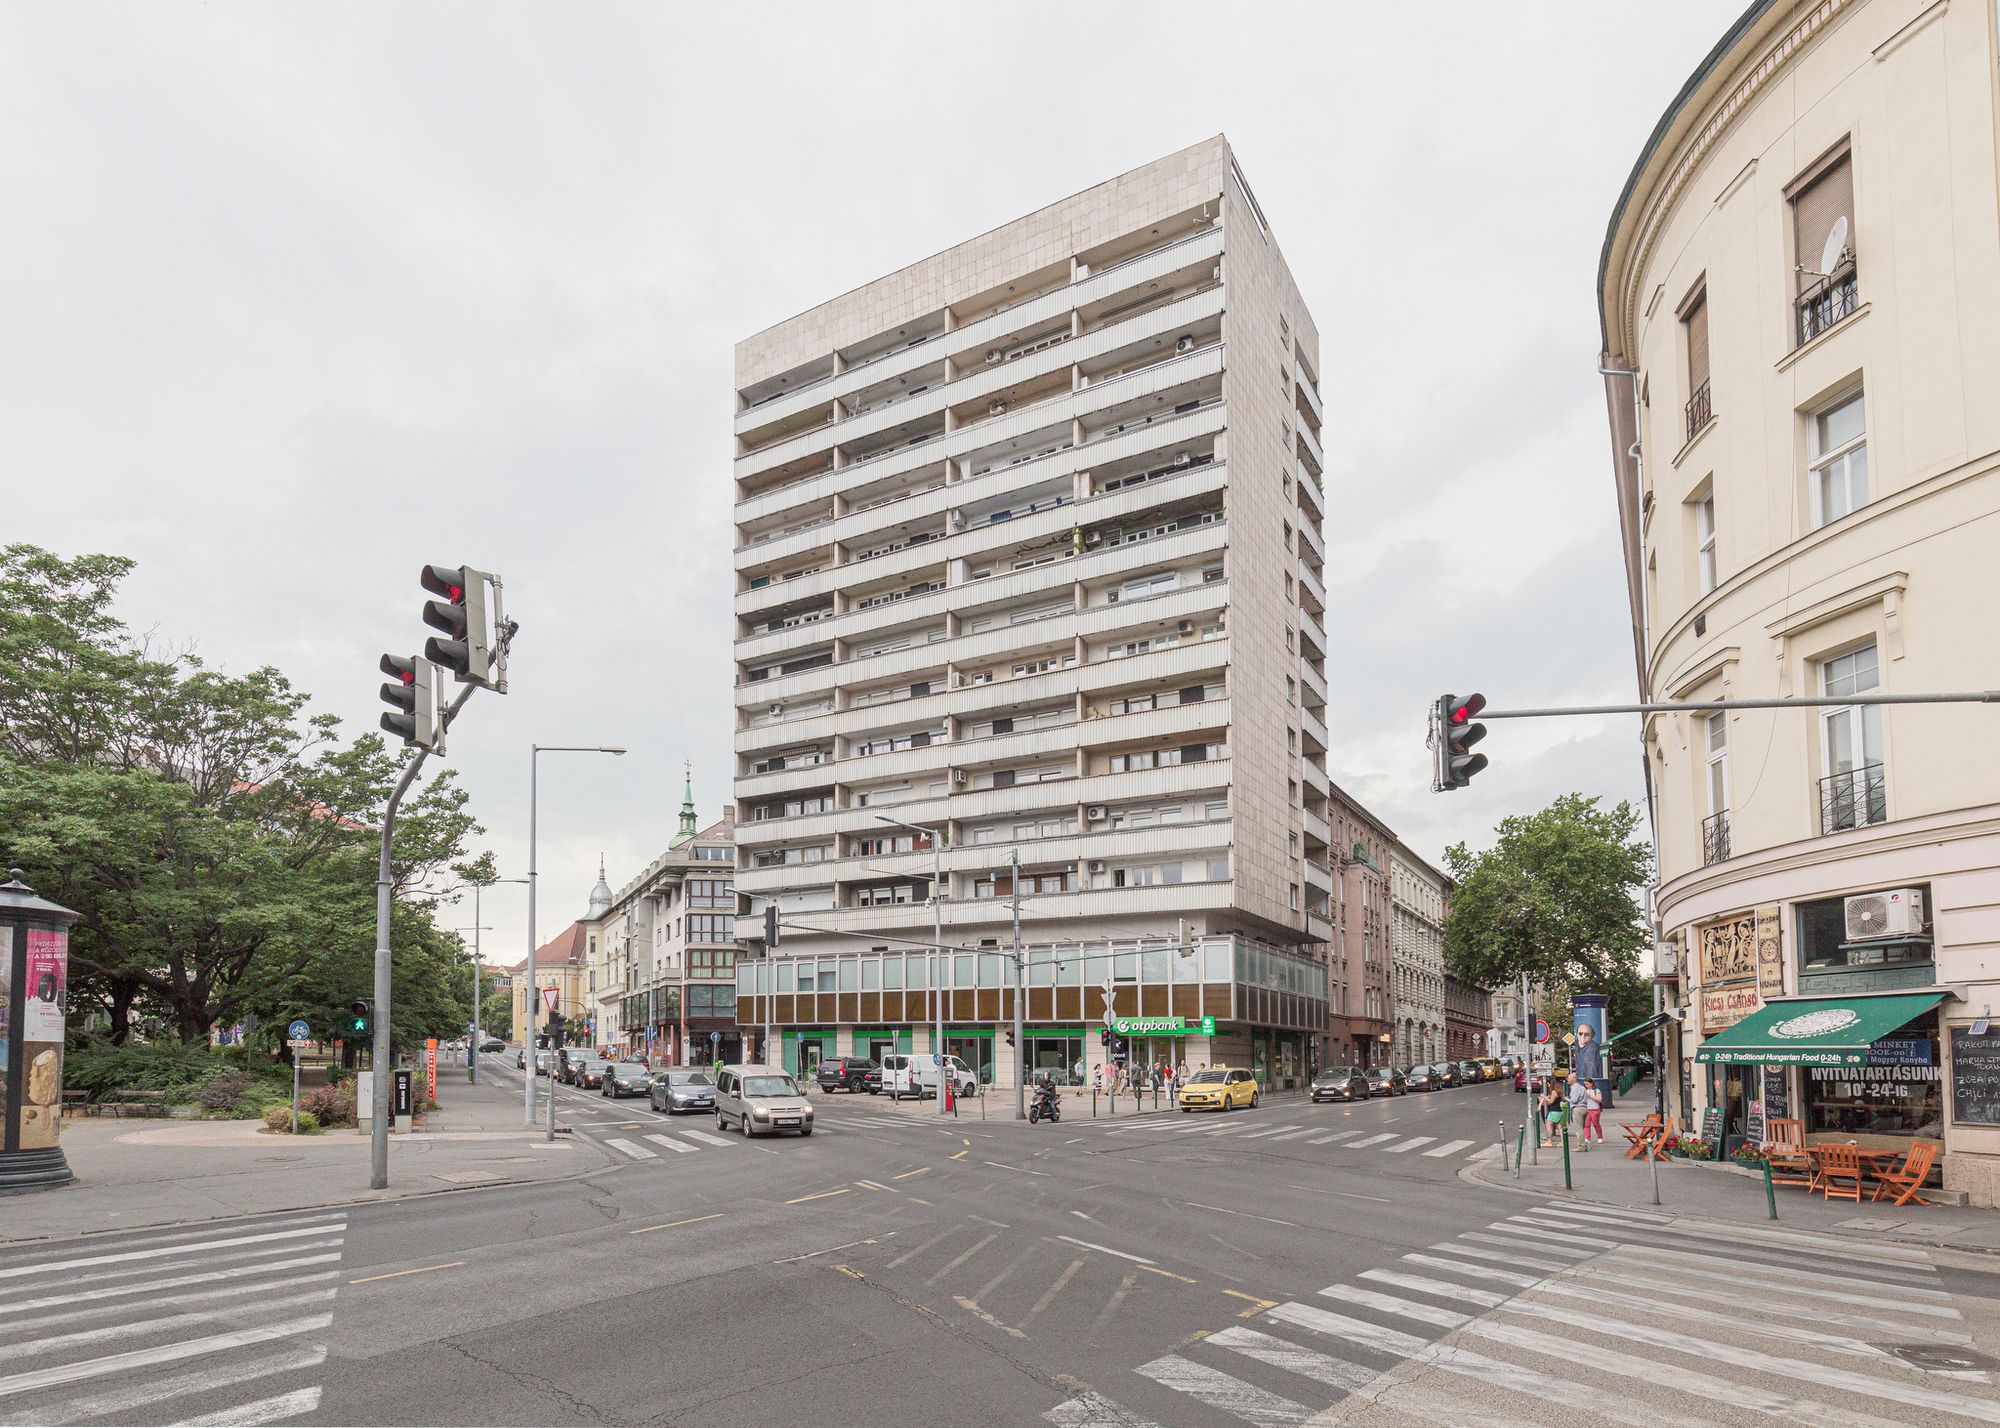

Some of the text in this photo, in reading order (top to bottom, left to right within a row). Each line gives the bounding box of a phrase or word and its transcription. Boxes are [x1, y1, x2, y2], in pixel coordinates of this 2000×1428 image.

[1705, 997, 1724, 1011] KICSI
[1132, 1019, 1178, 1033] otpbank
[1873, 1041, 1916, 1049] MINKET
[1715, 1053, 1841, 1063] 0-24h Traditional Hungarian Food 0-24h
[1870, 1056, 1928, 1065] Magyar Konyha
[1811, 1064, 1942, 1080] NYITVATARTÁSUNK
